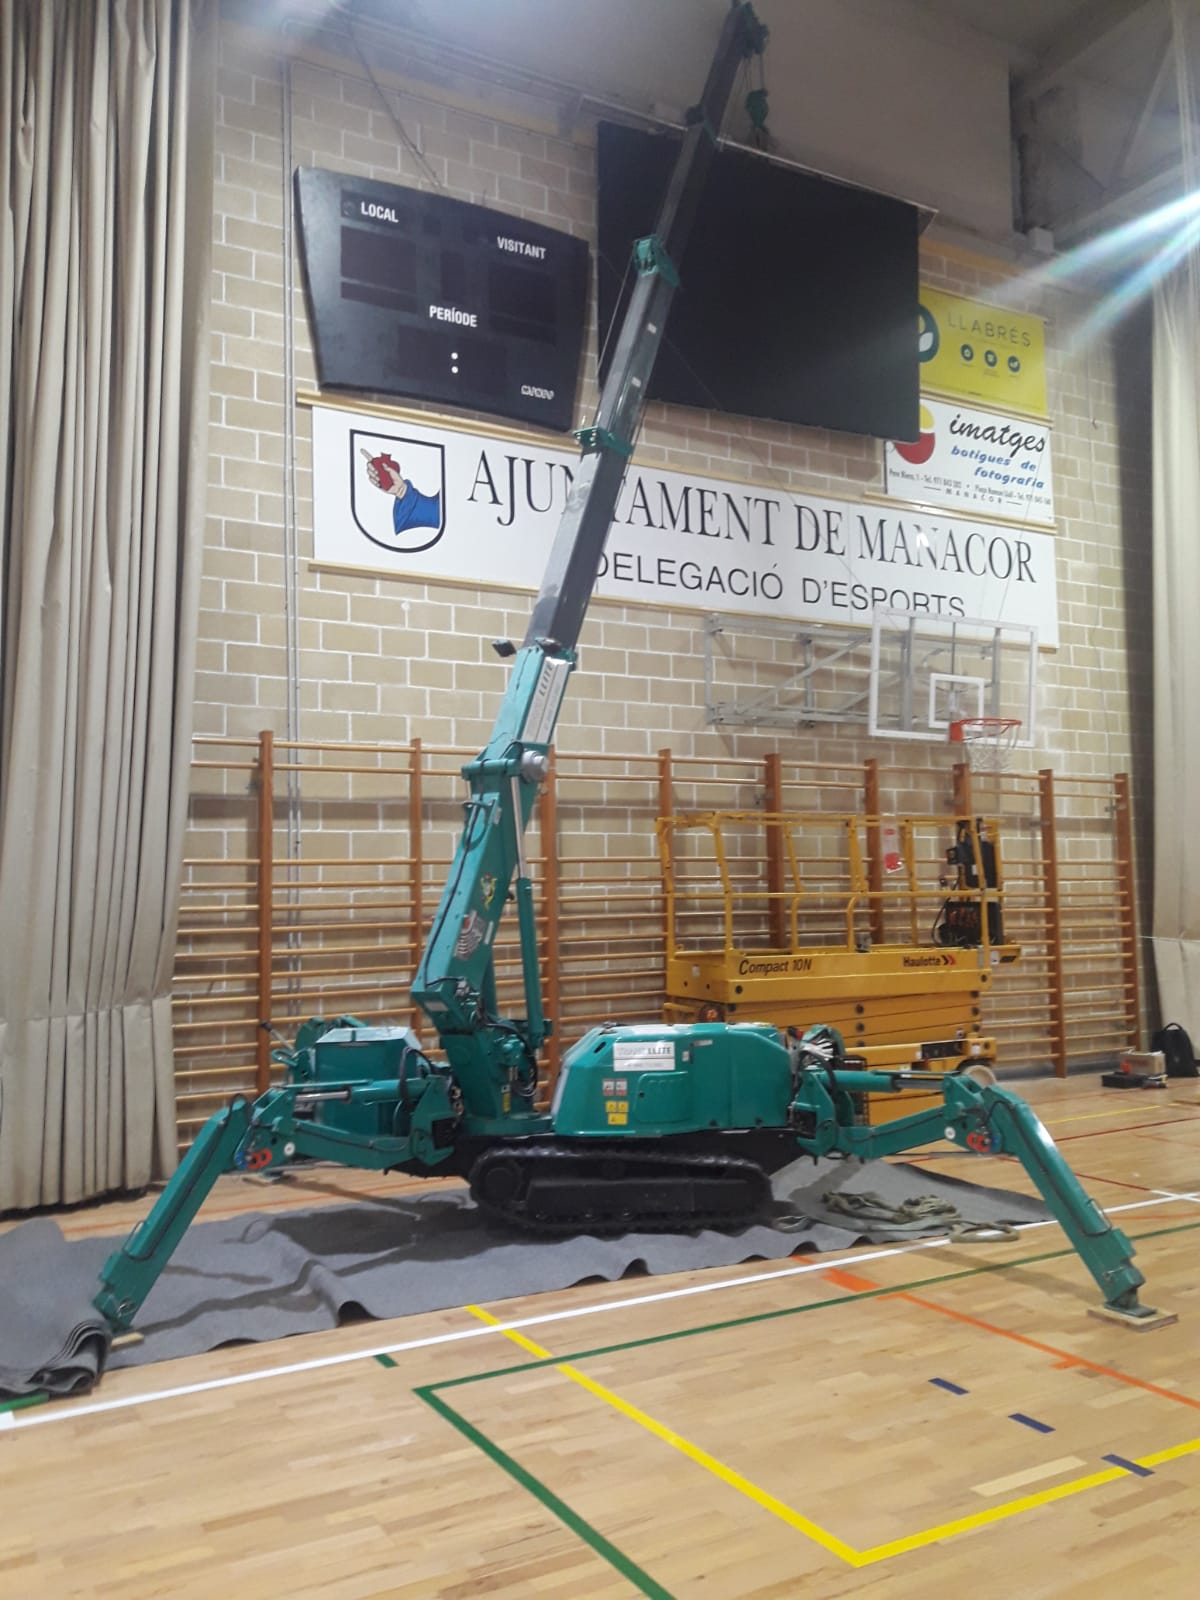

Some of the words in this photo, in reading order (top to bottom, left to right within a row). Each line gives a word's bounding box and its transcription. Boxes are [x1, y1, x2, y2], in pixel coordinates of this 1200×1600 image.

[361, 202, 399, 223] LOCAL
[497, 236, 546, 259] VISITANT
[429, 303, 478, 328] PERÍODE
[949, 414, 1046, 457] imatges
[951, 446, 1011, 467] botigues
[1021, 459, 1037, 472] de
[974, 466, 1045, 489] fotografia
[467, 450, 780, 546] AJUAMENT
[794, 504, 846, 556] DE
[856, 515, 1037, 583] MANACOR
[802, 577, 966, 617] D'ESPORTS
[739, 959, 789, 976] Compact
[792, 958, 812, 972] 10N
[903, 955, 941, 967] Haulotte
